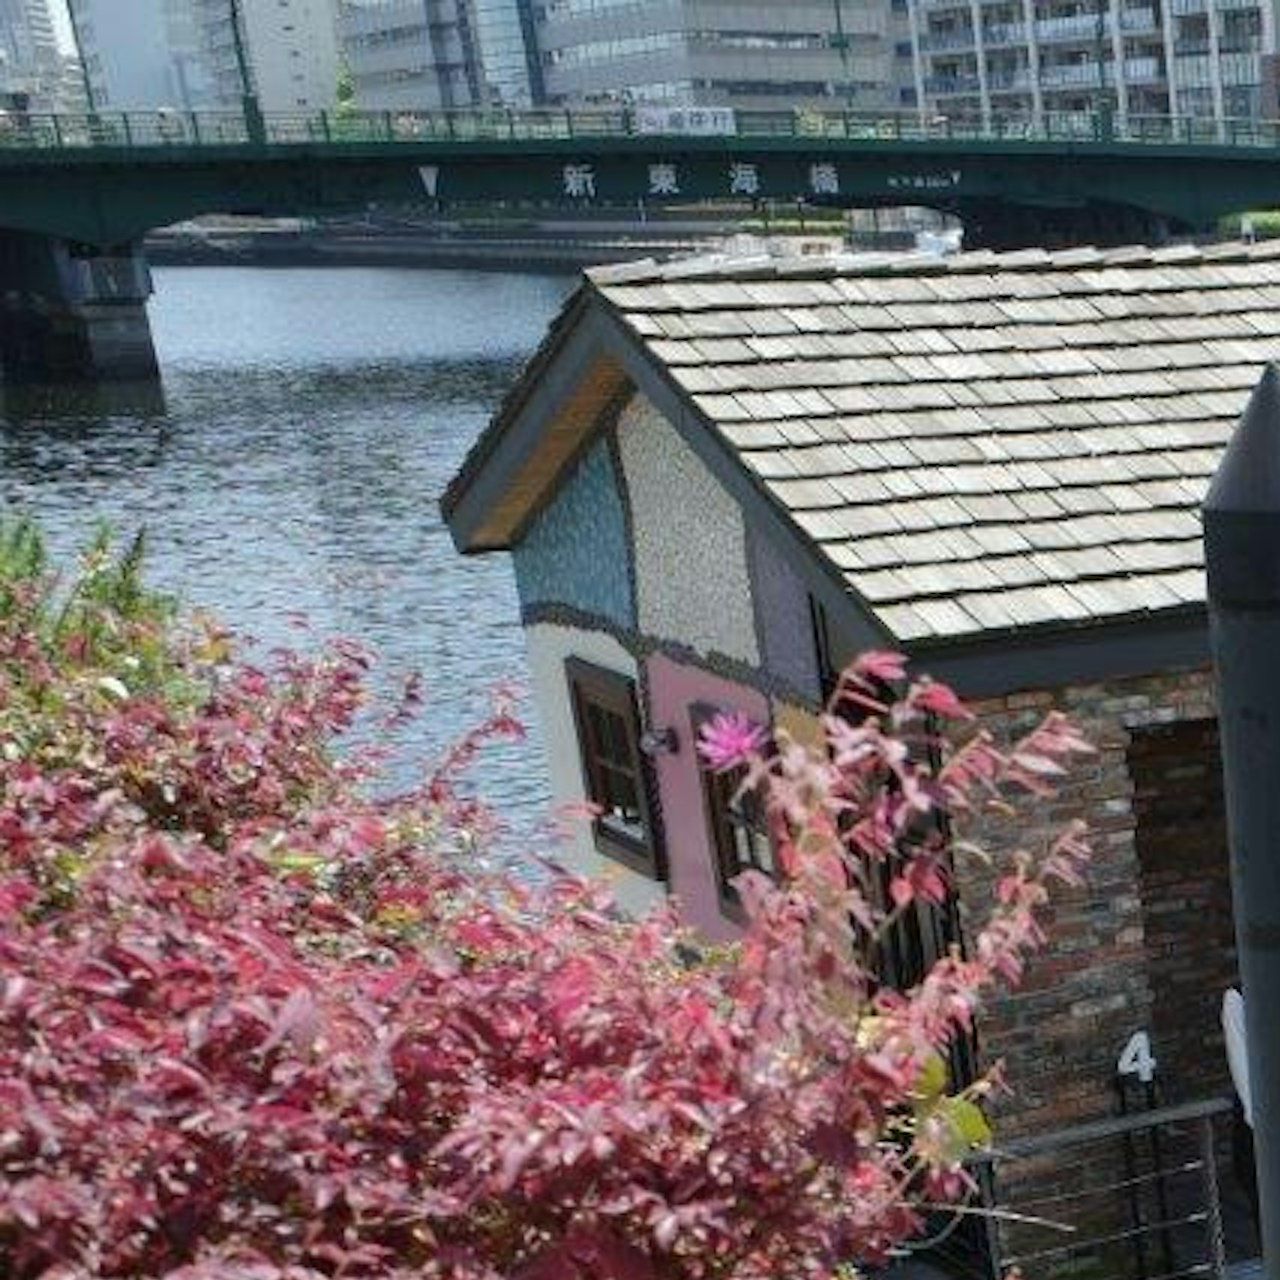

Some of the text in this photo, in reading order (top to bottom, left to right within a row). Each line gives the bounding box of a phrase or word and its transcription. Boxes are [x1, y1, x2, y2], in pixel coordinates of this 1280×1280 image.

[563, 163, 839, 197] 新東海橋
[1117, 1031, 1157, 1081] 4
